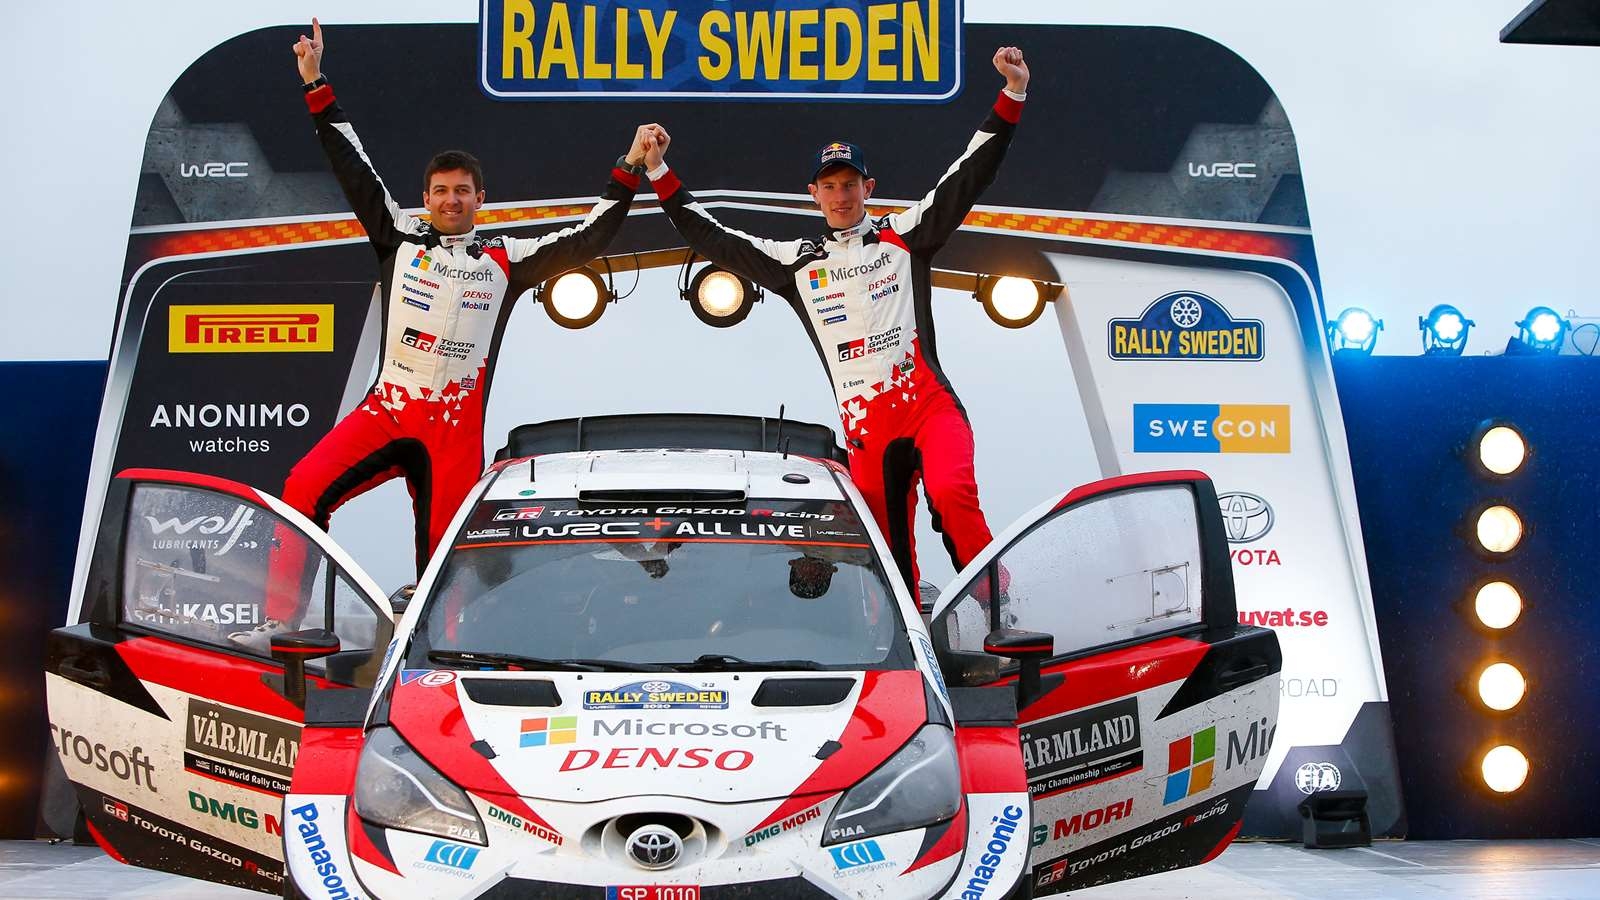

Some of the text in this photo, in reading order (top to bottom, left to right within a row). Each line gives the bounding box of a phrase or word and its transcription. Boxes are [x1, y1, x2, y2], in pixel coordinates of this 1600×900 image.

[502, 0, 940, 82] RALLY SWEDEN
[180, 161, 249, 178] WRC
[1188, 162, 1257, 178] WRC
[433, 261, 494, 282] Microsoft
[829, 252, 892, 283] Microsoft
[403, 272, 440, 290] DMG MORI
[868, 272, 898, 292] DENSO
[402, 283, 435, 300] Panasonic
[462, 290, 493, 300] DENSO
[812, 291, 846, 304] DMG MORI
[870, 287, 893, 302] Mobil
[461, 301, 483, 311] Mobil
[817, 303, 846, 315] Panasonic
[185, 313, 320, 344] PIRELLI
[867, 326, 902, 341] TOYOTA
[401, 334, 433, 352] GR
[441, 338, 476, 349] TOYOTA
[867, 333, 900, 349] GAZOO
[867, 339, 900, 355] Racing
[1115, 325, 1258, 355] RALLY SWEDEN
[433, 349, 468, 361] Racing
[438, 345, 471, 354] GAZOO
[840, 345, 865, 361] GR
[842, 379, 865, 389] E. Evans
[150, 403, 310, 428] ANONIMO
[1149, 419, 1278, 437] SWECON
[189, 436, 271, 453] watches
[495, 506, 835, 522] GR TOYOTA GAZOO Racing
[675, 522, 732, 536] ALL
[740, 523, 806, 538] LIVE
[152, 539, 219, 550] LUBRICANTS
[125, 603, 260, 625] sahiKASEI
[1238, 607, 1329, 627] uvat.se
[589, 691, 723, 703] RALLY SWEDEN
[592, 719, 788, 742] Microsoft
[192, 710, 300, 769] VÄRMLAN
[558, 747, 755, 773] DENSO
[214, 764, 228, 775] FIA
[228, 768, 250, 782] World
[251, 775, 271, 789] Rally
[1027, 783, 1047, 795] Rally
[1048, 768, 1101, 789] Championship
[188, 790, 260, 829] DMG
[487, 805, 564, 847] DMG MORI
[744, 806, 822, 848] DMG MORI
[1053, 797, 1134, 841] MORI
[103, 803, 130, 822] GR
[130, 814, 187, 846] TOYOTA
[189, 839, 243, 868] GAZOO
[447, 825, 481, 841] PIAA
[830, 824, 866, 840] PIAA
[952, 805, 1023, 900] anasonic
[1037, 801, 1229, 887] GR TOYOTA GAZOO Racing
[620, 887, 697, 900] SP 1010
